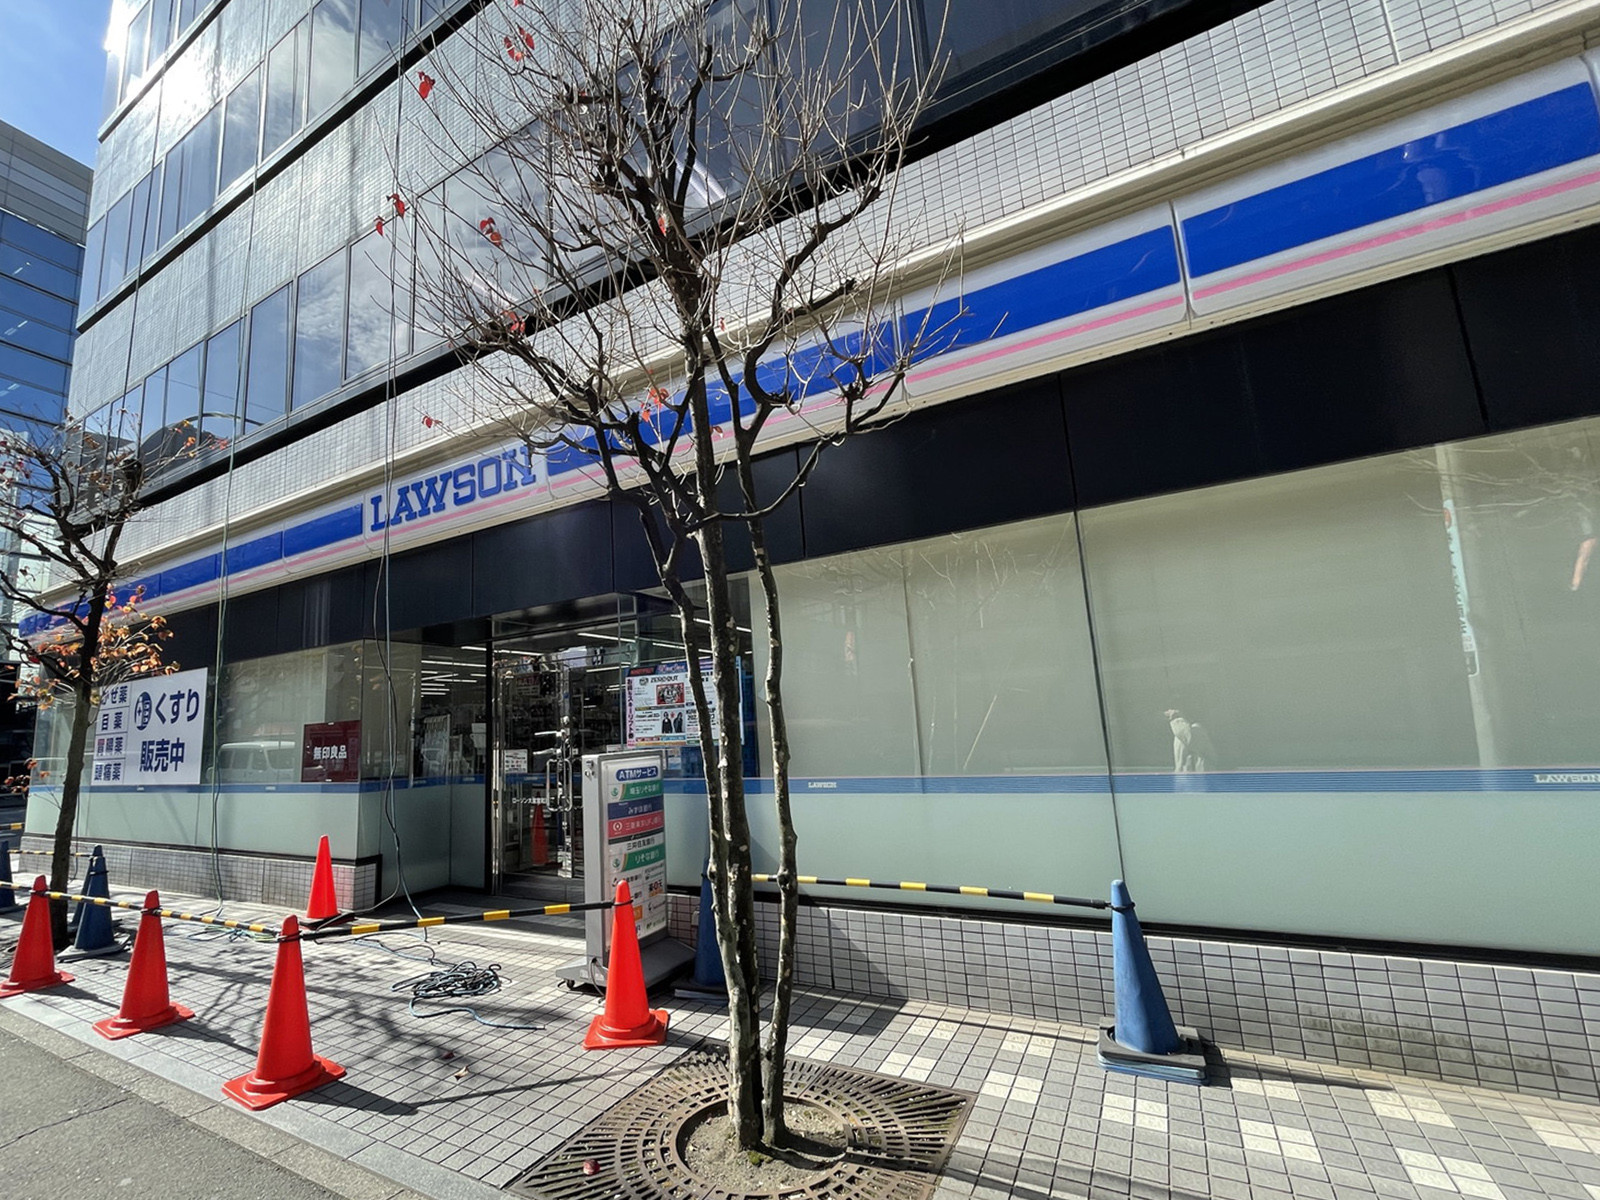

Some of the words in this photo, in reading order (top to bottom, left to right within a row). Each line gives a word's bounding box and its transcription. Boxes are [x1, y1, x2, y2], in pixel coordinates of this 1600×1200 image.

[371, 445, 536, 531] LAWSON
[155, 688, 200, 725] くすり
[101, 711, 123, 731] 目薬
[139, 737, 186, 773] 販売中
[313, 744, 347, 760] 無印良品
[618, 767, 657, 780] ATMサービス
[1533, 773, 1600, 784] LAWSON
